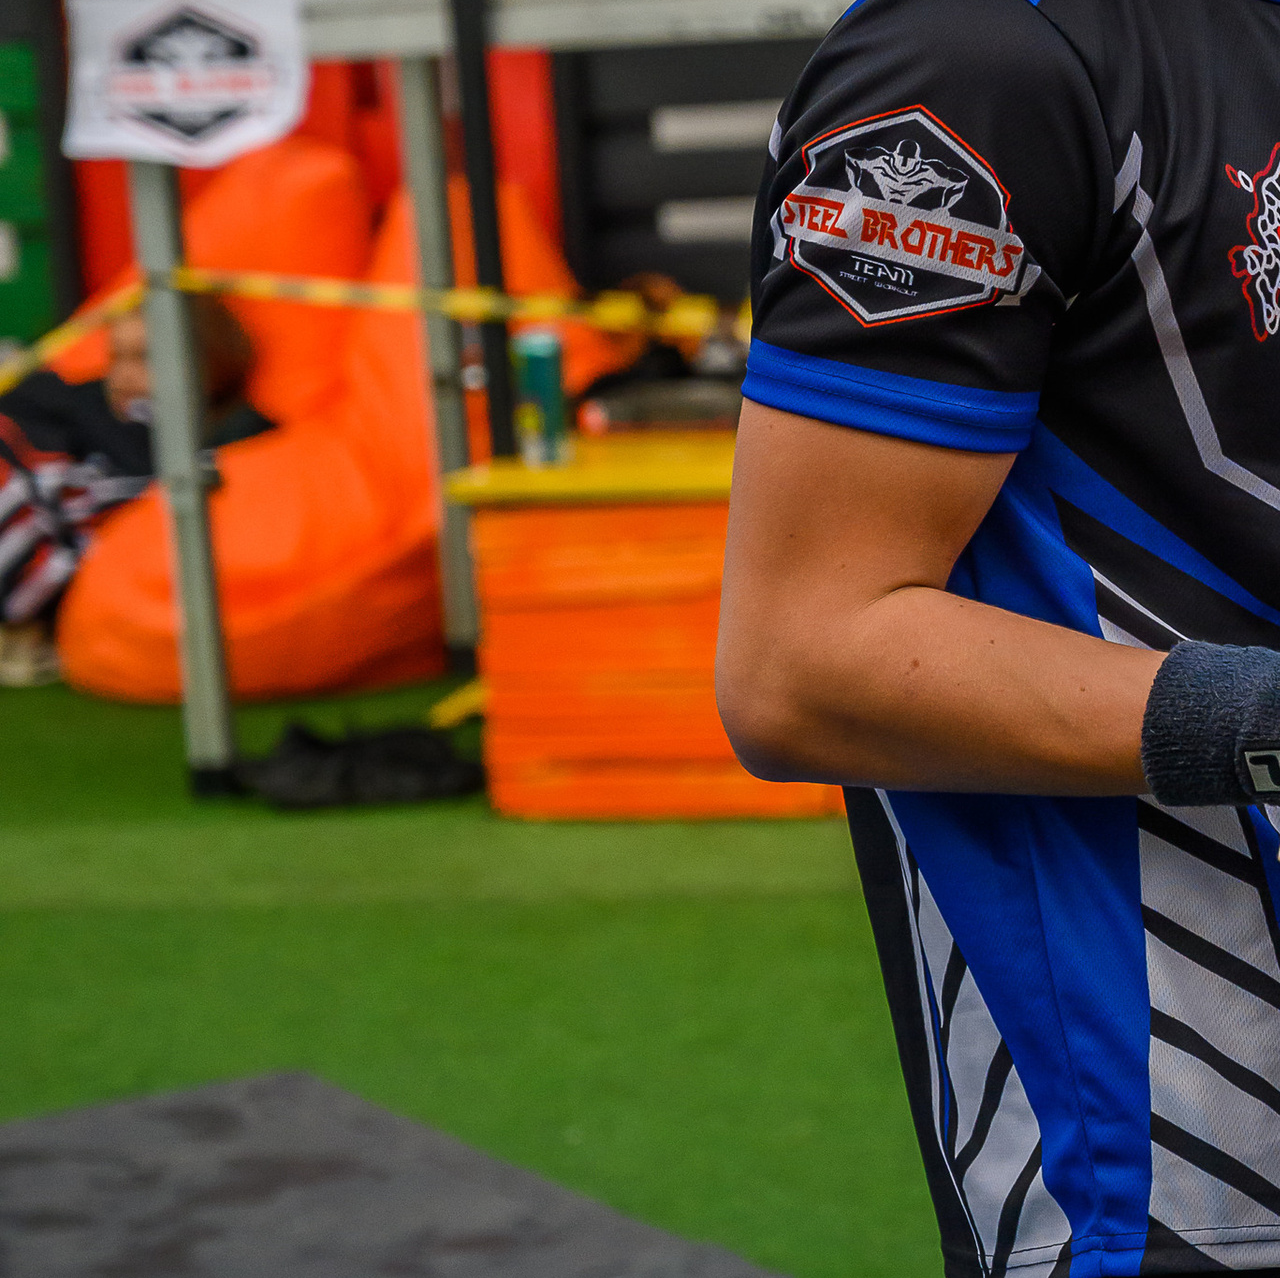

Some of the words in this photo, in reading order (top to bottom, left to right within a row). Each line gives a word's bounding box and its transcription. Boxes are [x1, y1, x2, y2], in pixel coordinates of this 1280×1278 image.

[783, 192, 849, 239] STEEL
[860, 207, 1023, 278] BROTHERS
[839, 270, 869, 283] STREET
[874, 281, 919, 297] WORKOUT
[850, 255, 914, 286] TEAM
